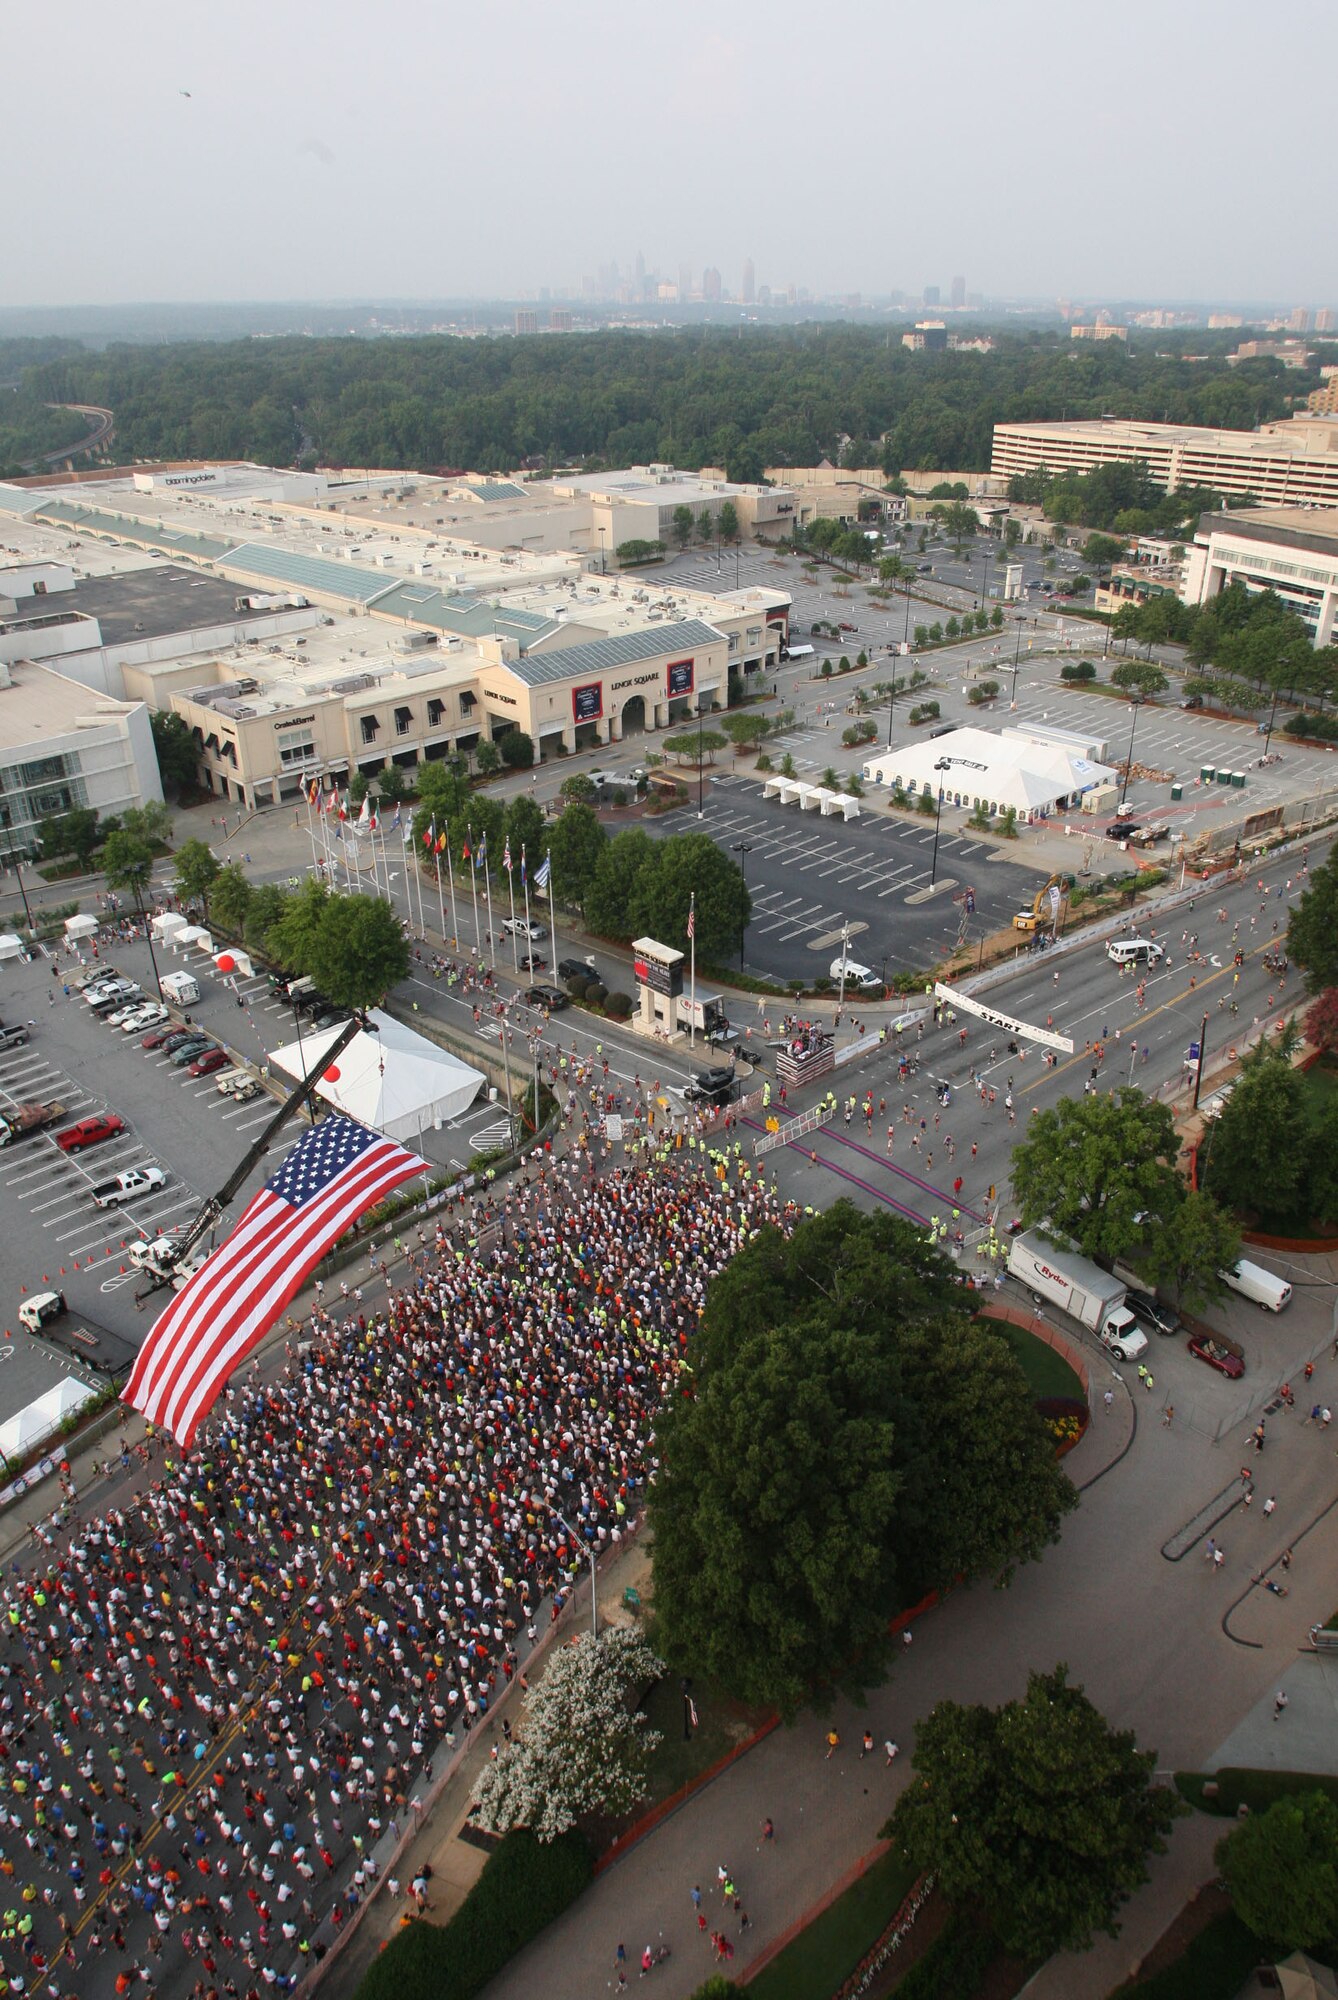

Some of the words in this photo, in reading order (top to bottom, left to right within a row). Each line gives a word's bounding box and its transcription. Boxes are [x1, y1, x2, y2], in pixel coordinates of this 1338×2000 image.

[611, 680, 633, 691] LENOX
[634, 672, 659, 686] SQUARE
[684, 1000, 701, 1012] Ryer
[980, 1012, 1022, 1032] START
[1041, 1265, 1069, 1288] Ryder
